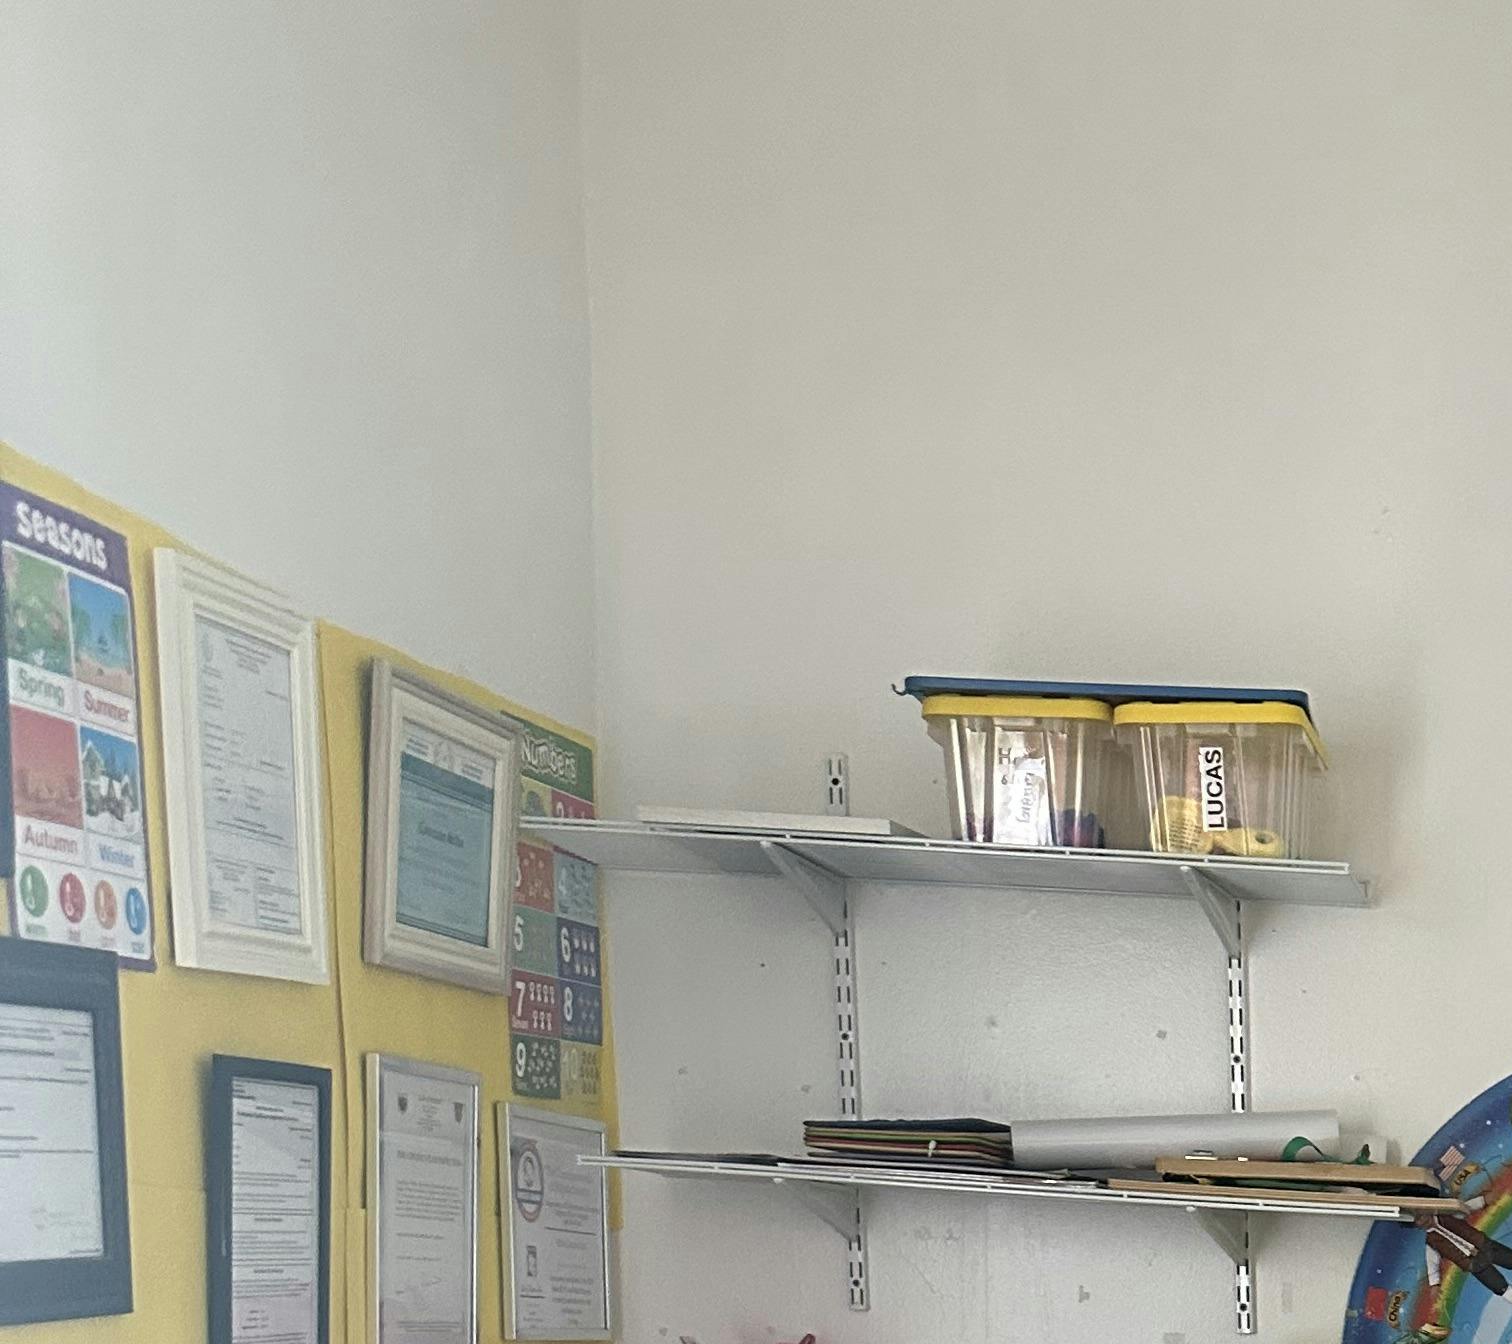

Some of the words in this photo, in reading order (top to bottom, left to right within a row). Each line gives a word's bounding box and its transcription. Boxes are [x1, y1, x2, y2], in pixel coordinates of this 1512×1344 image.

[19, 667, 65, 708] Spring
[84, 690, 130, 723] Summer
[521, 734, 577, 784] Numbers
[1206, 749, 1226, 828] LUCAS
[24, 825, 78, 854] Autumn
[513, 914, 524, 952] 5
[560, 927, 571, 963] 6
[515, 980, 526, 1017] 7
[563, 986, 573, 1022] 8
[516, 1042, 526, 1077] 9
